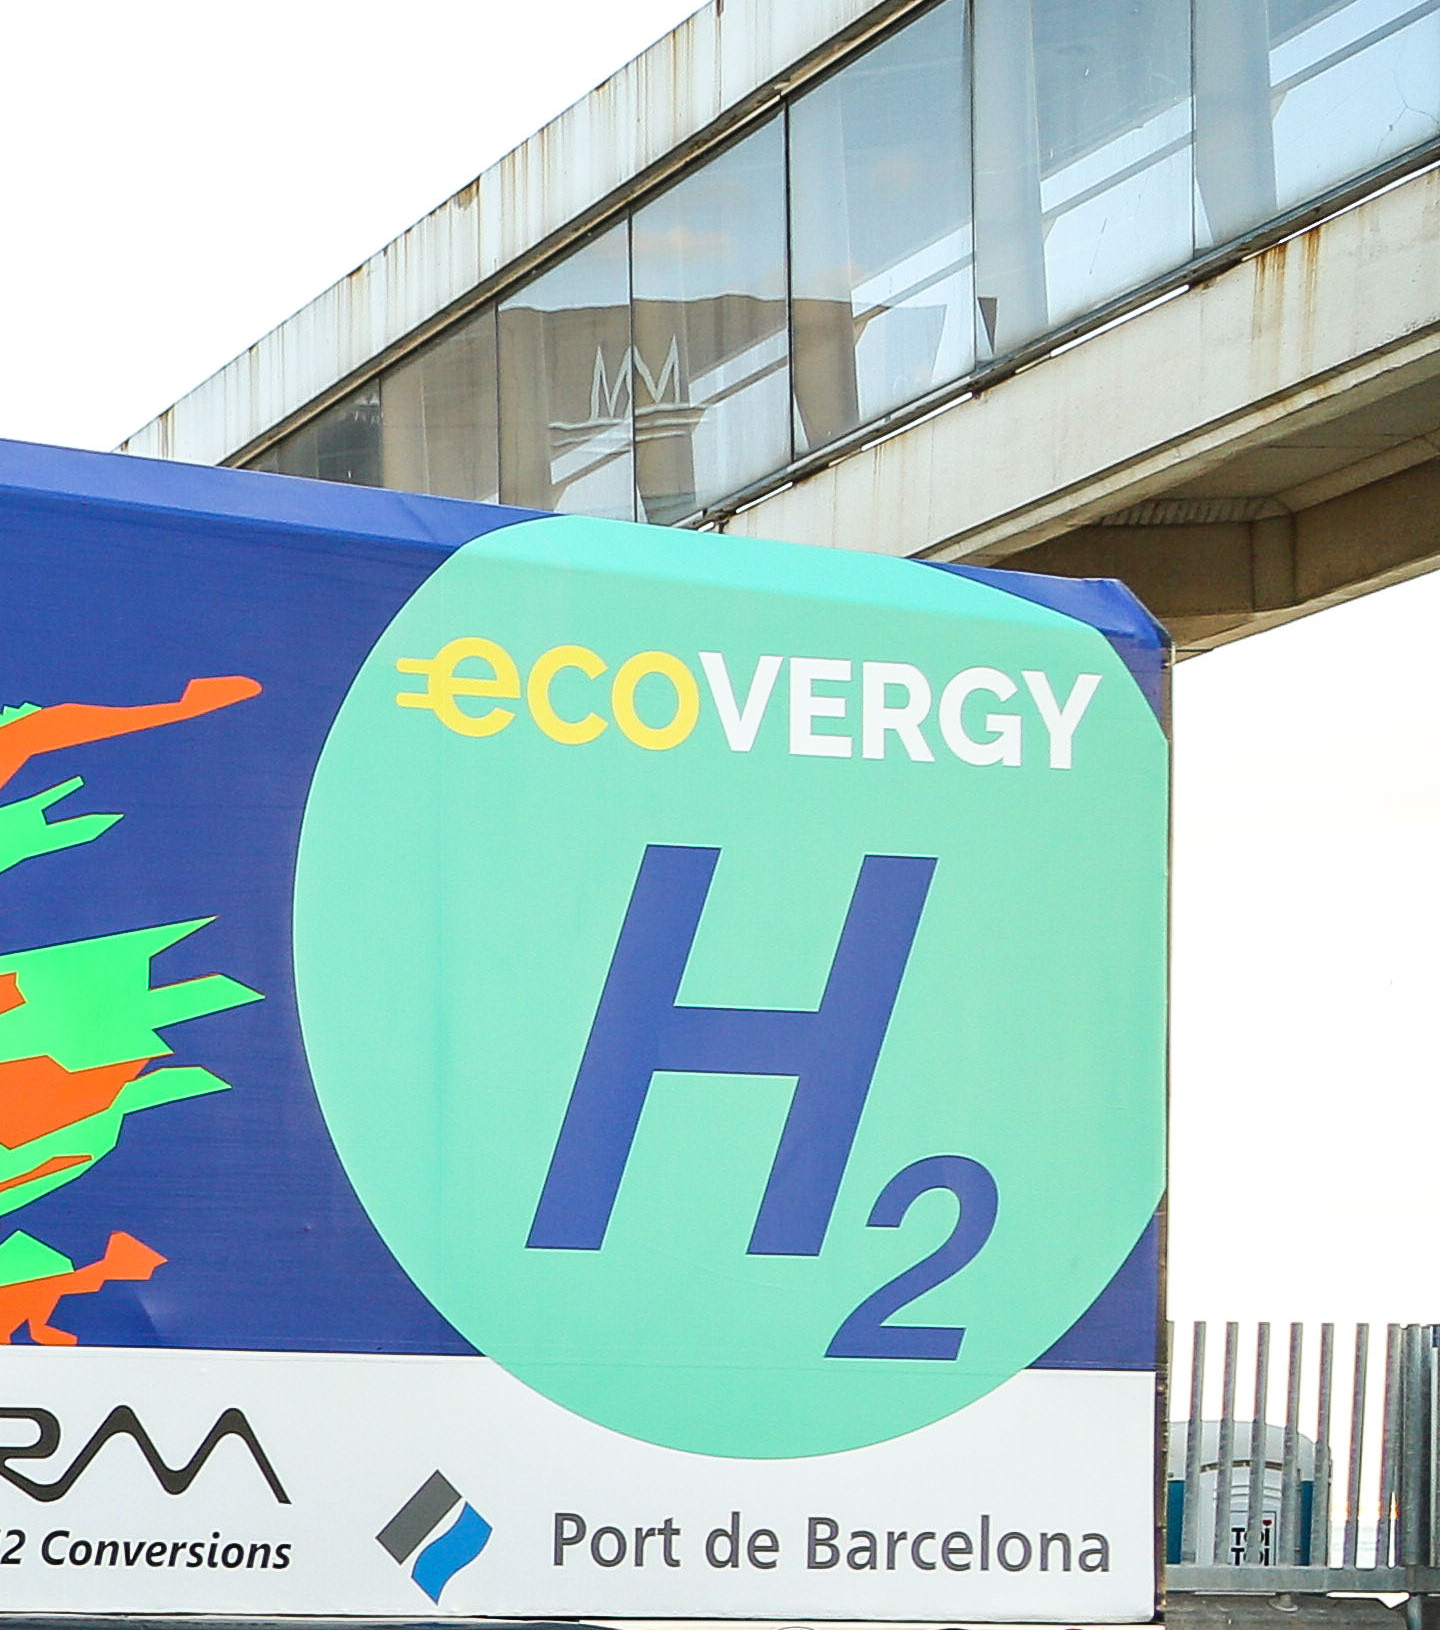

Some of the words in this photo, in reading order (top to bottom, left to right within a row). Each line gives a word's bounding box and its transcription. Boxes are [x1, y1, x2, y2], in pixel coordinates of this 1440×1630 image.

[40, 1529, 294, 1571] Conversions
[552, 1511, 683, 1570] Port
[704, 1510, 782, 1571] de
[807, 1514, 1113, 1575] Barcelona
